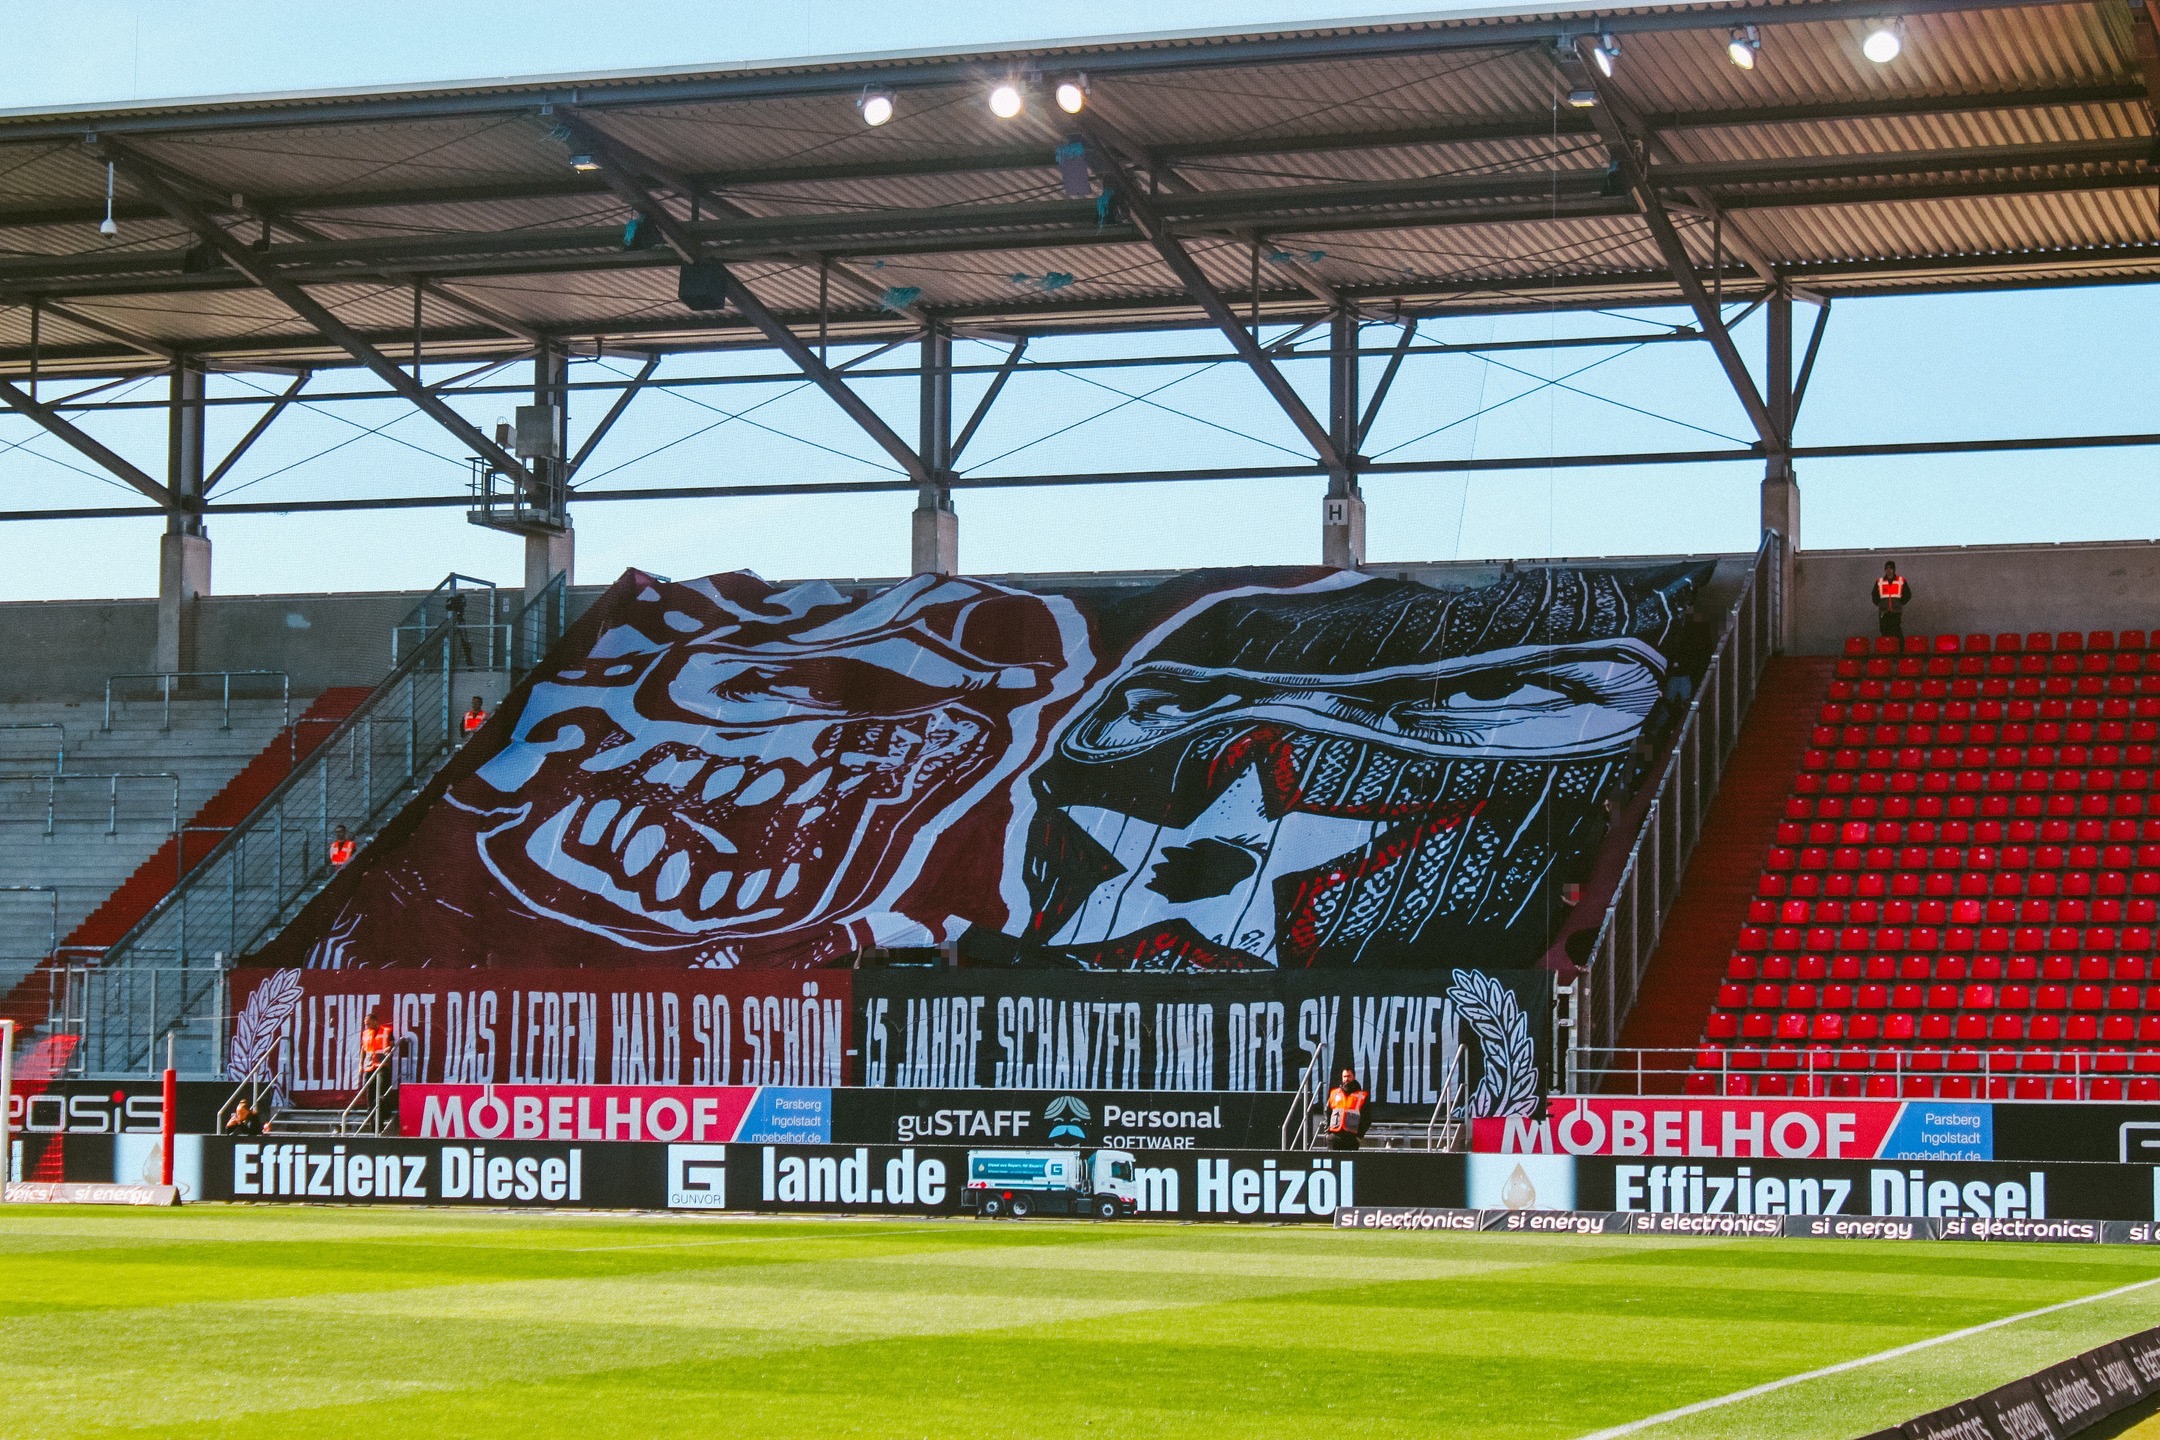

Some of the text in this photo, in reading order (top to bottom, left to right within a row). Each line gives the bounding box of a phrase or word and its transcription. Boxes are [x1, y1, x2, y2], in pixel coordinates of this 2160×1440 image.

[1329, 504, 1342, 520] H
[443, 991, 497, 1084] DAS
[509, 991, 597, 1085] LEBEN
[611, 992, 680, 1086] HALB
[692, 994, 731, 1087] SO
[743, 981, 842, 1087] SCHÖN
[865, 997, 888, 1087] 15
[897, 996, 985, 1088] JAHRE
[1154, 1003, 1213, 1091] UND
[1228, 1001, 1285, 1091] DER
[775, 1098, 822, 1112] Parsberg
[771, 1114, 821, 1128] Ingolstadt
[897, 1110, 1031, 1142] guSTAFF
[1103, 1105, 1222, 1129] Personal
[1925, 1113, 1981, 1128] Parsberg
[751, 1132, 821, 1143] moebelhof.de
[1102, 1135, 1195, 1149] SOFTWARE
[1921, 1131, 1981, 1146] Ingolstadt
[234, 1144, 582, 1201] Effizienz Diesel
[762, 1146, 947, 1204] land.de
[1197, 1158, 1354, 1216] Heizöl
[1615, 1164, 2045, 1219] Effizienz Diesel
[672, 1193, 721, 1206] GUNVOR
[1340, 1211, 1475, 1228] si electronics
[1507, 1211, 1605, 1234] si energy
[1637, 1213, 1777, 1232] si electronics
[1811, 1218, 1913, 1240] si energy
[1946, 1218, 2094, 1238] si electronics
[2129, 1223, 2149, 1241] si
